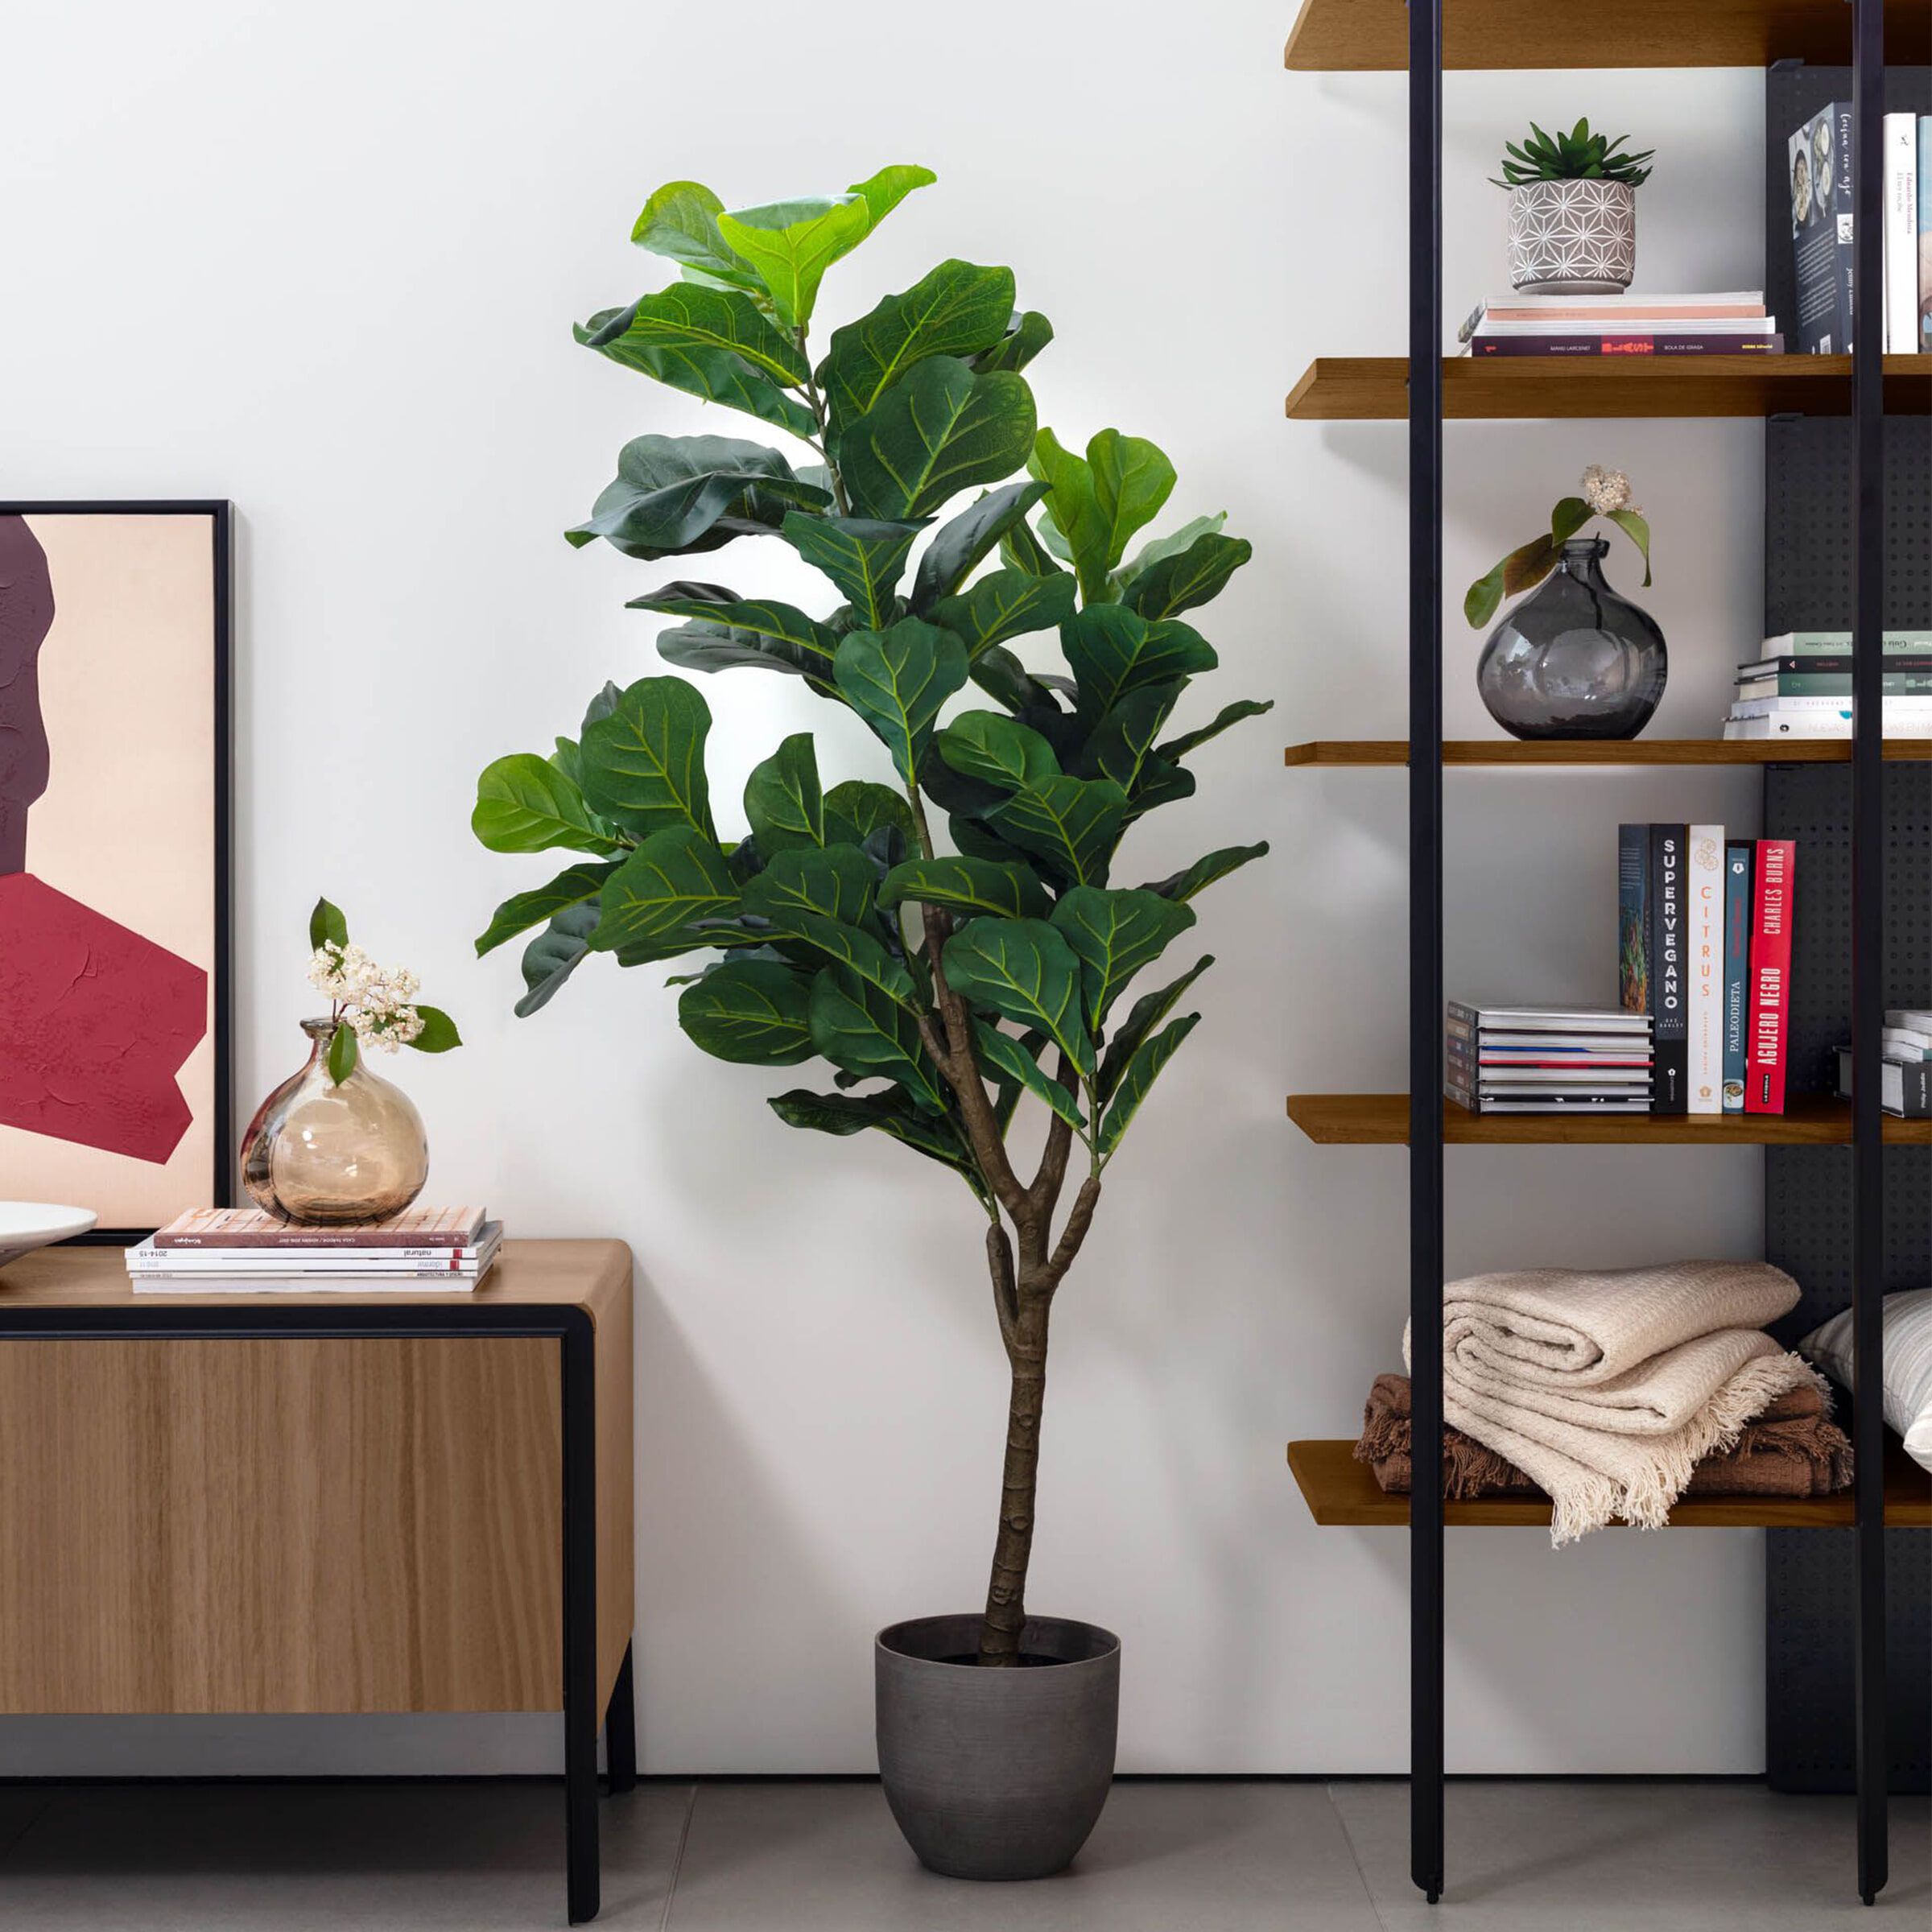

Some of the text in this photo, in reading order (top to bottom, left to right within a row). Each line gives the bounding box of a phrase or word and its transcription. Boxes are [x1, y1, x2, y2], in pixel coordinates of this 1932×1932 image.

[1663, 839, 1678, 1009] SUPERVEGANO
[1763, 848, 1784, 935] CHARLES BURNS
[1700, 886, 1712, 997] CITRUS
[1729, 980, 1740, 1053] PALEODIETA
[1757, 968, 1781, 1065] AGUJERO NEGRO
